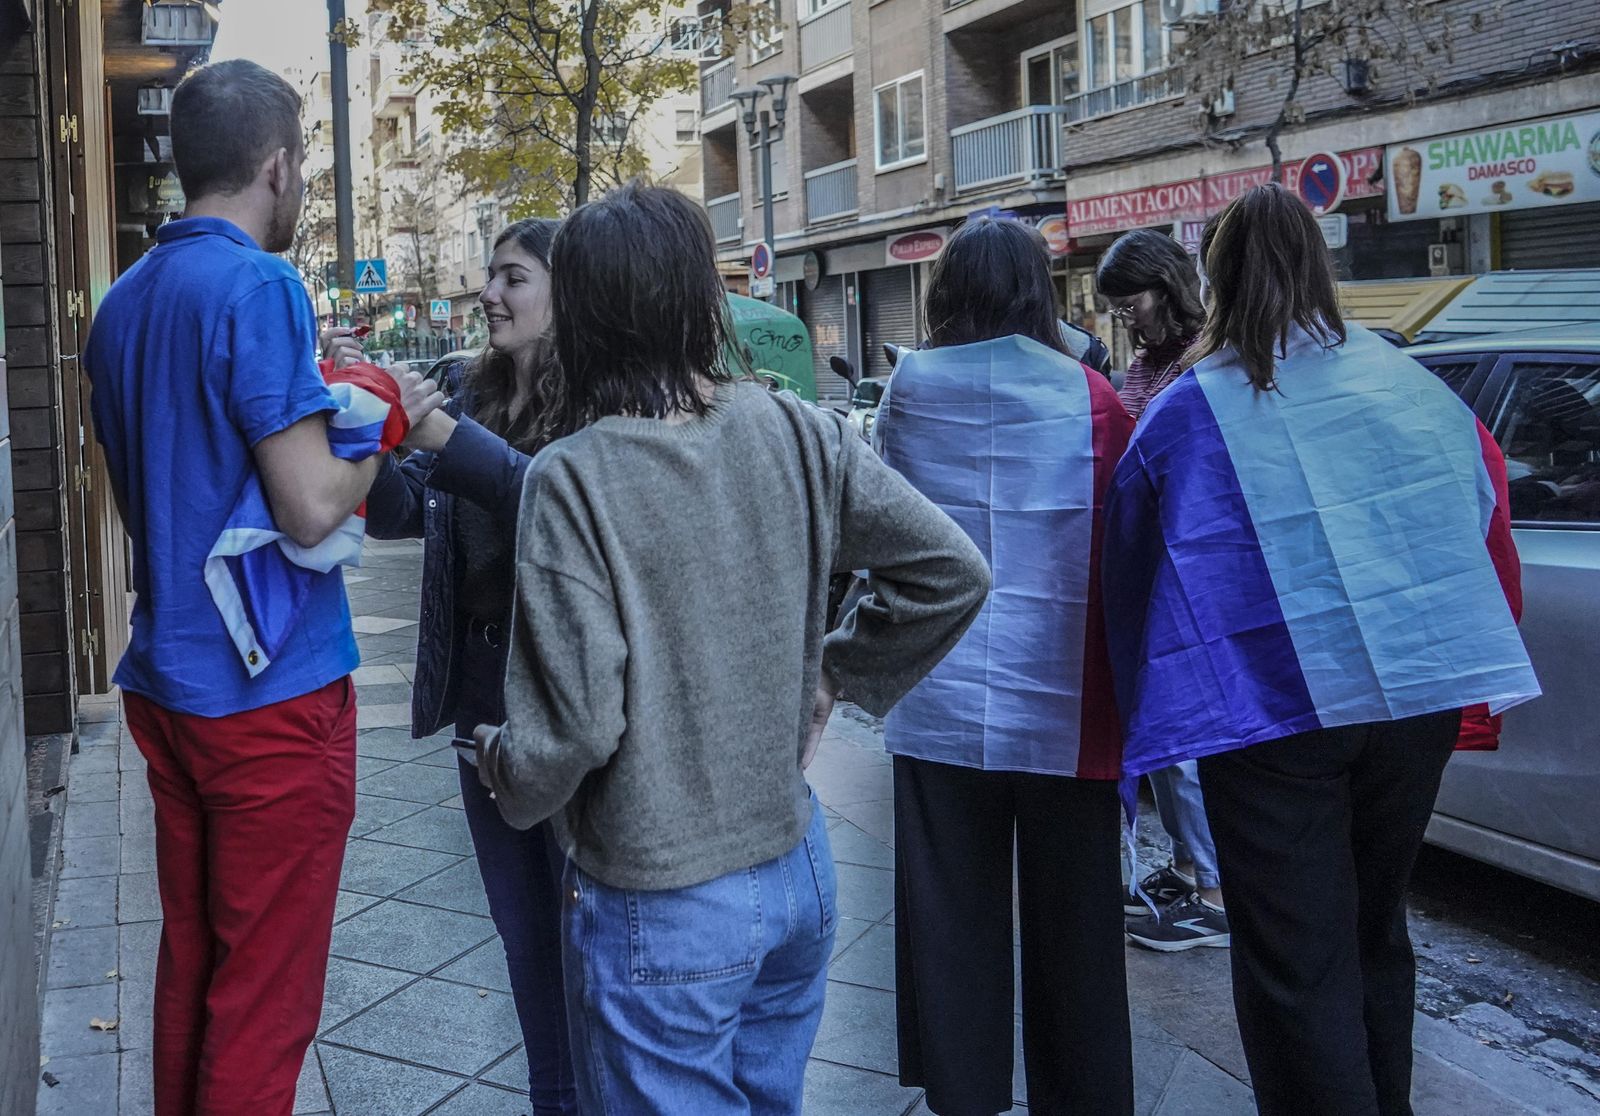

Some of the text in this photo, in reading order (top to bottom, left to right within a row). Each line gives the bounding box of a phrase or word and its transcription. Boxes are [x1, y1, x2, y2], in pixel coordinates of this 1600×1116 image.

[1428, 121, 1581, 170] SHAWARMA
[1468, 158, 1536, 181] DAMASCO
[1069, 180, 1203, 224] ALIMENTACION
[1286, 152, 1381, 191] EPA
